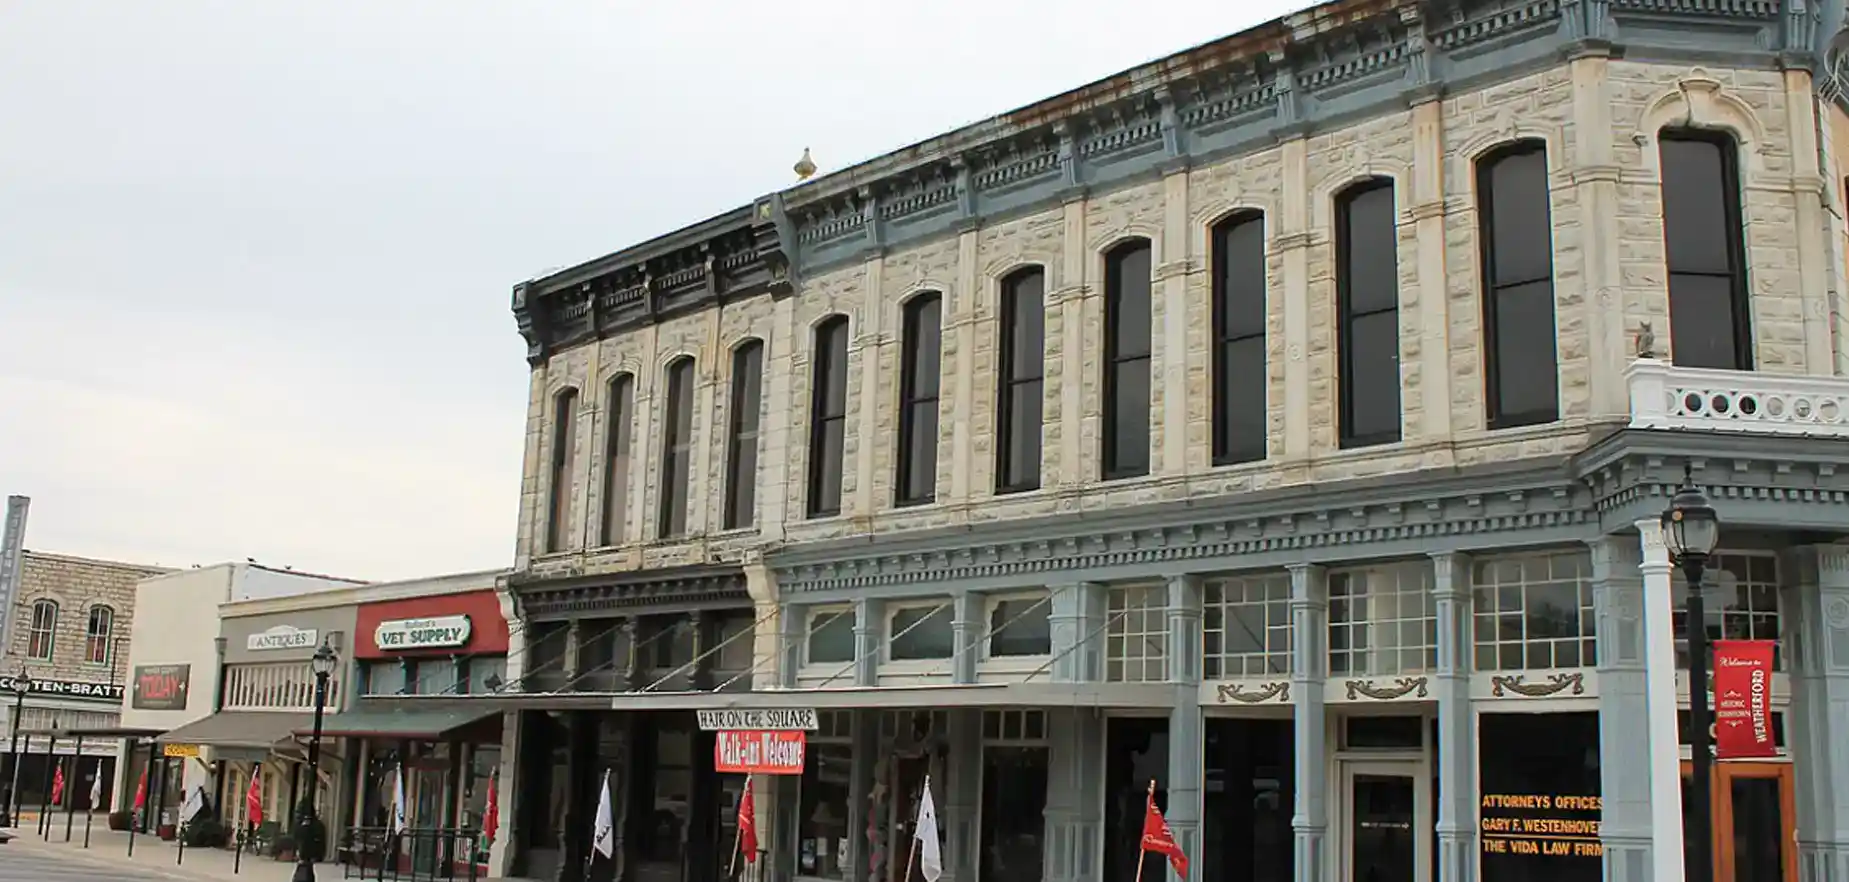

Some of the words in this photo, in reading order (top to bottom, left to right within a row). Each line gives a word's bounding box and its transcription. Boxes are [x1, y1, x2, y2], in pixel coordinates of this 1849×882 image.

[256, 632, 306, 648] ANTIQUES
[382, 631, 406, 645] VET
[409, 627, 461, 643] SUPPLY
[1719, 656, 1752, 668] Welcome
[1751, 669, 1767, 743] WEATHERFORD
[699, 711, 725, 728] HAIR
[727, 710, 742, 727] ON
[744, 710, 764, 728] THE
[766, 708, 814, 728] SQUARE
[761, 731, 803, 767] Welcome
[1482, 794, 1551, 809] ATTORNEYS
[1482, 818, 1510, 830] GARY
[1483, 840, 1506, 852] THE
[1509, 841, 1539, 854] VIDA
[1542, 841, 1570, 855] LAW
